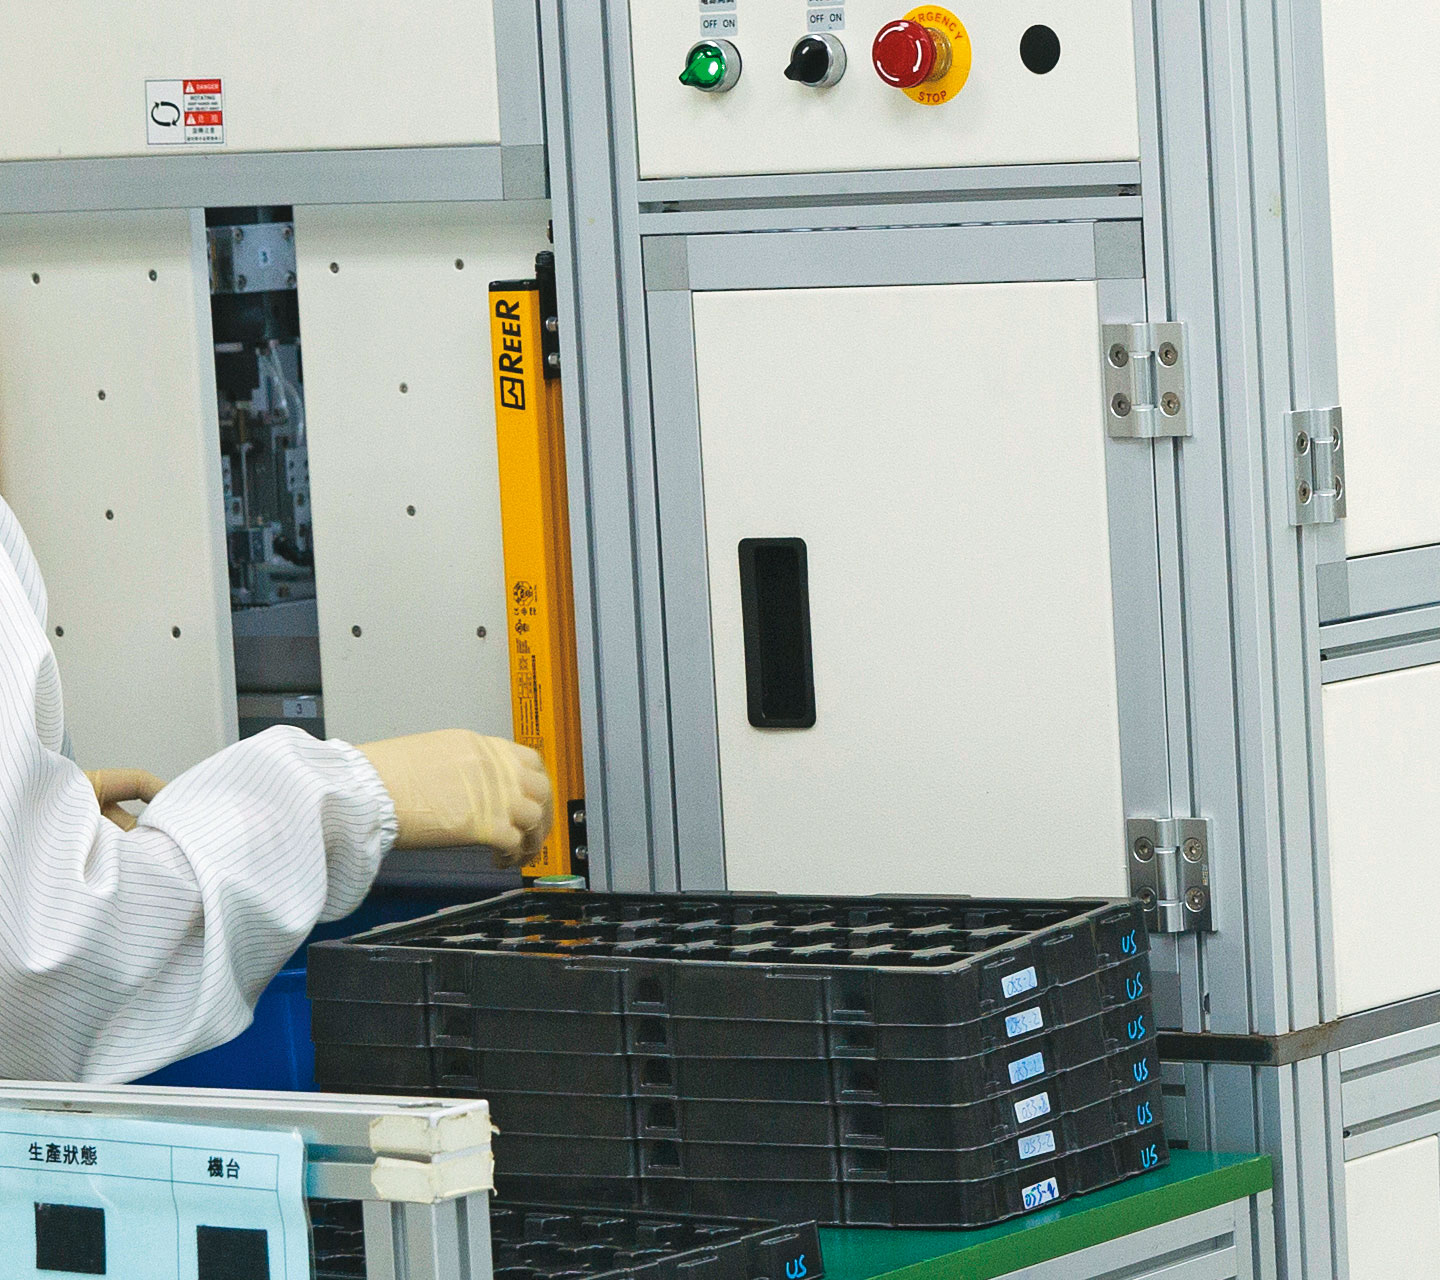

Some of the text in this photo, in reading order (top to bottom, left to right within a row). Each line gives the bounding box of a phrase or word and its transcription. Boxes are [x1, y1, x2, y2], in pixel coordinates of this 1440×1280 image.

[703, 18, 736, 28] OFF ON
[810, 12, 842, 24] OFF ON
[918, 91, 948, 103] STOP
[495, 299, 524, 375] REER
[1121, 928, 1138, 955] US
[1126, 971, 1143, 1000] US
[1127, 1014, 1146, 1040] US
[1133, 1057, 1149, 1082] US
[1137, 1100, 1153, 1126] US
[28, 1141, 99, 1167] 生產狀態
[207, 1155, 241, 1179] 機台
[1141, 1143, 1158, 1169] US
[786, 1253, 807, 1279] US
